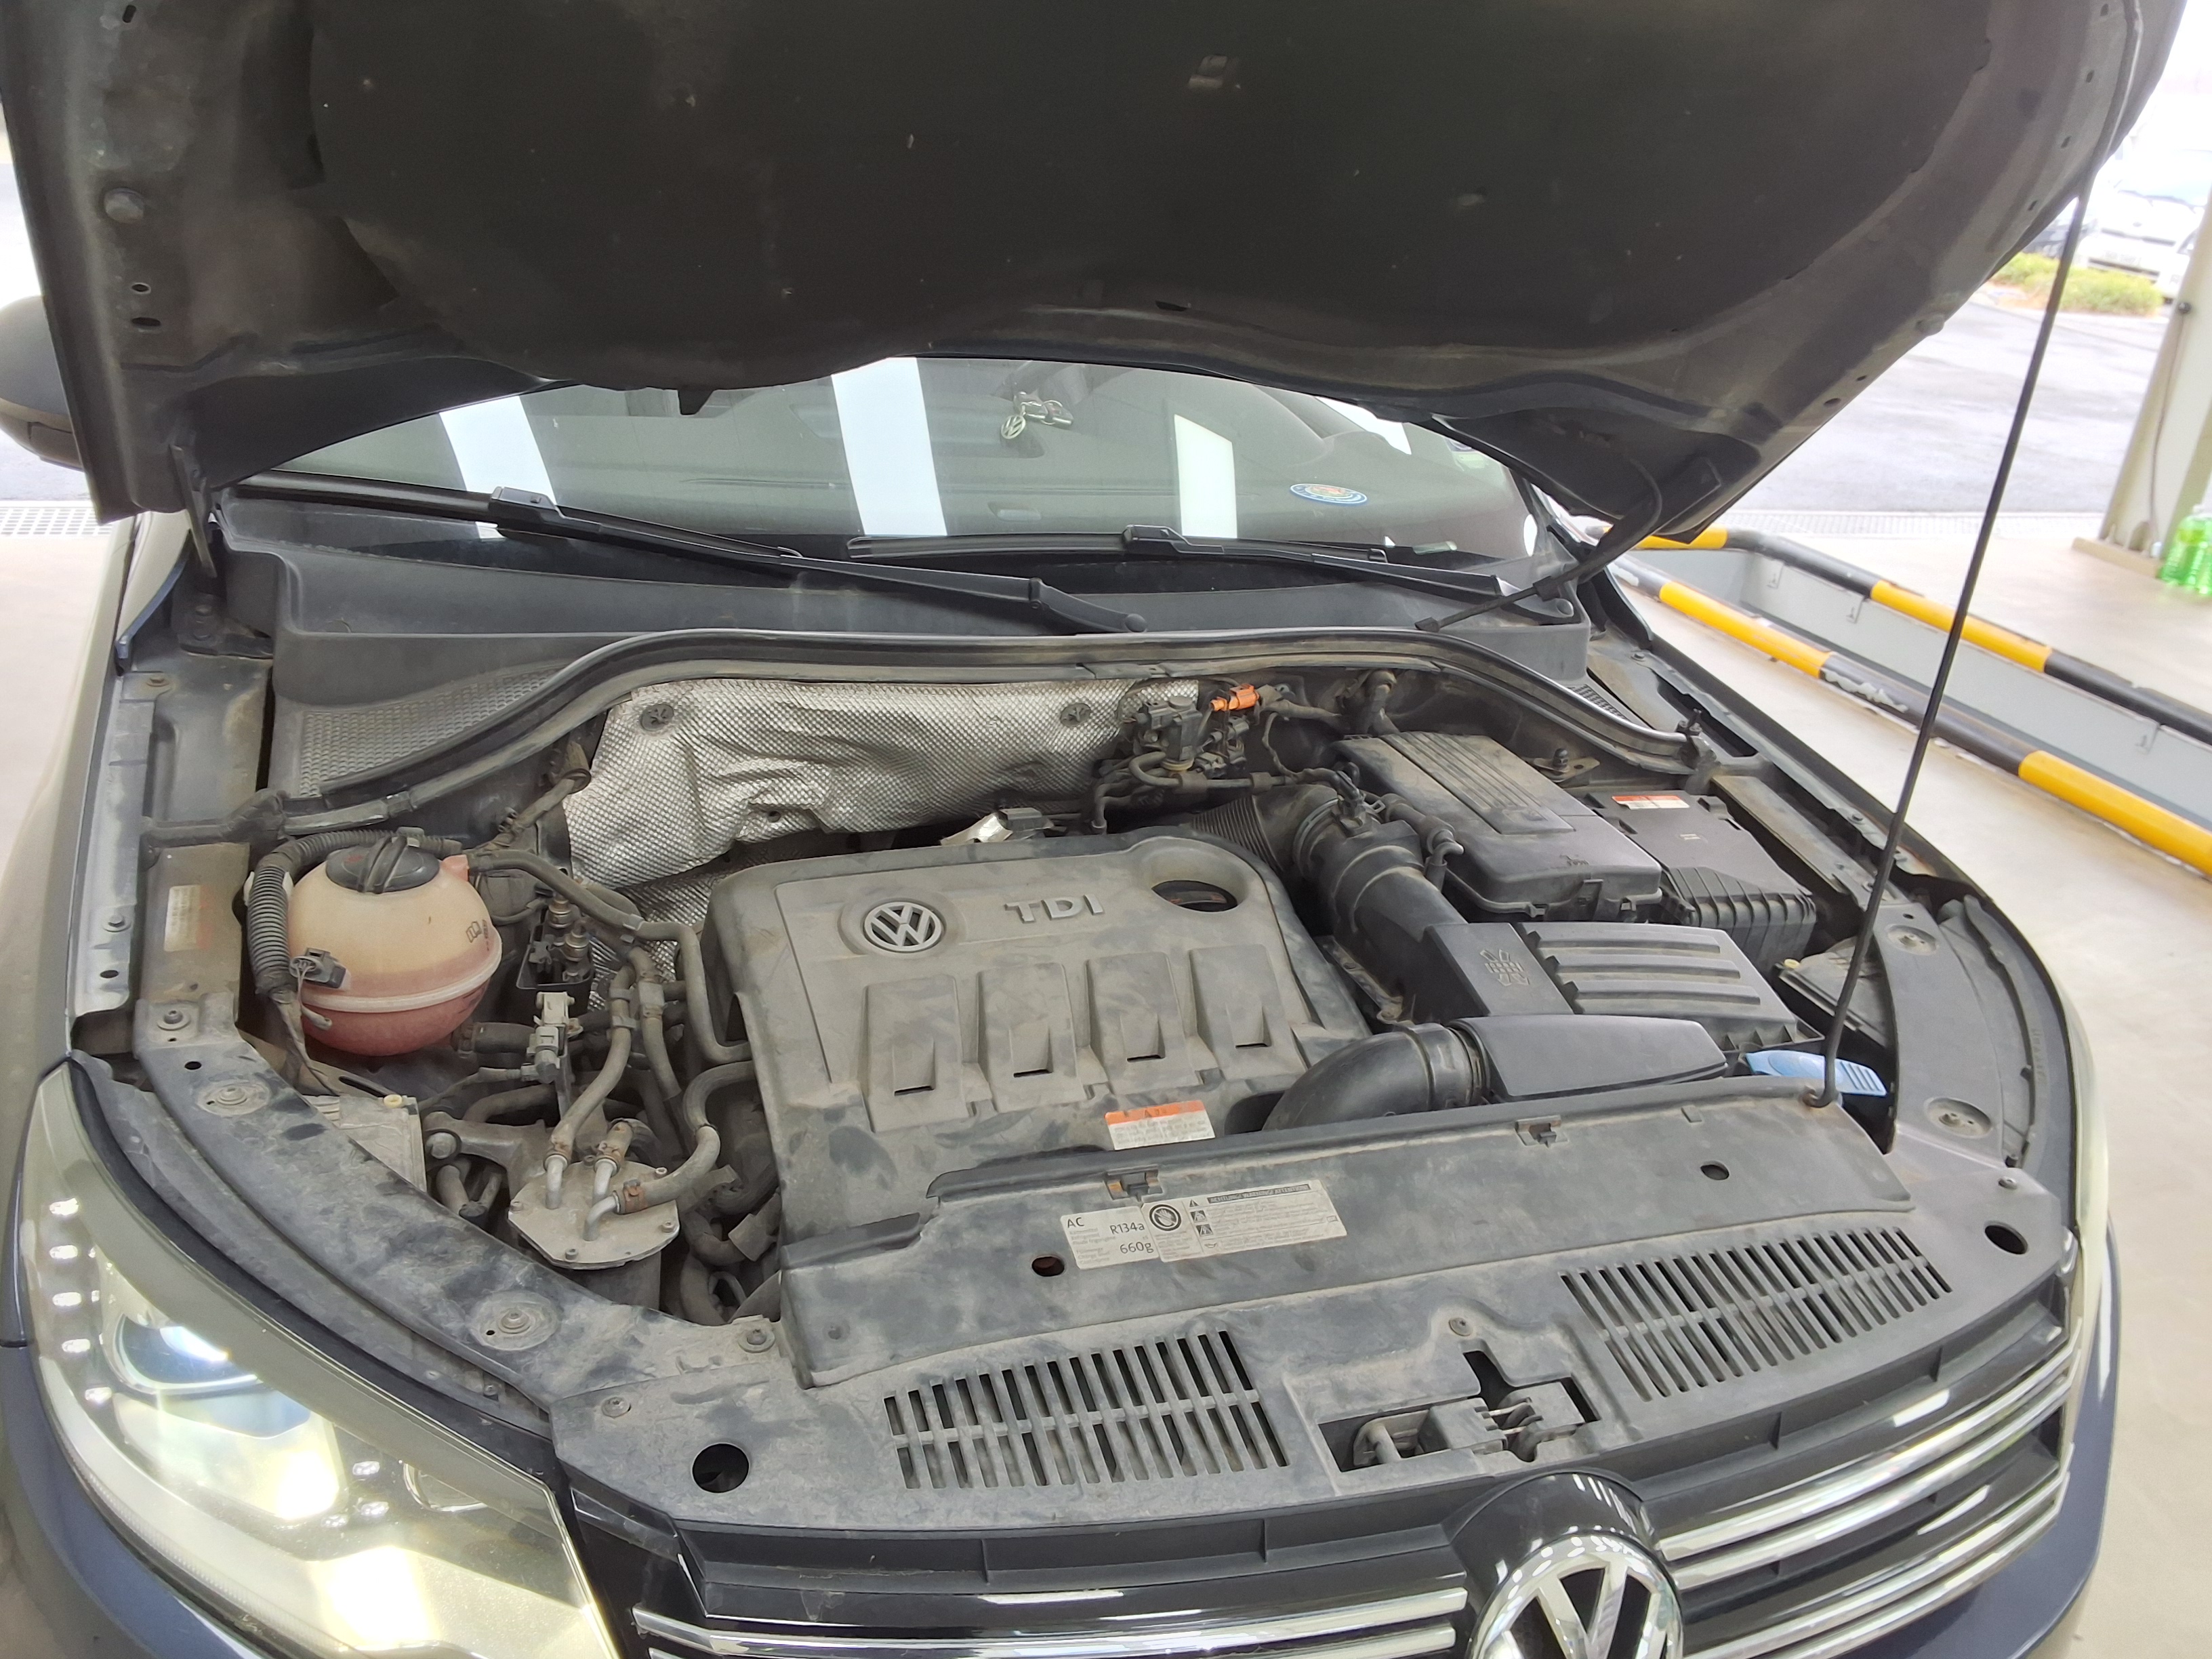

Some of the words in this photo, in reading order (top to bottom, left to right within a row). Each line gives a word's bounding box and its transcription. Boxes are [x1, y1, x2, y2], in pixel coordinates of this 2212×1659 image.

[1004, 893, 1105, 924] TDI
[1067, 1217, 1084, 1228] AC
[1109, 1222, 1145, 1235] R134a
[1120, 1241, 1154, 1254] 660g
